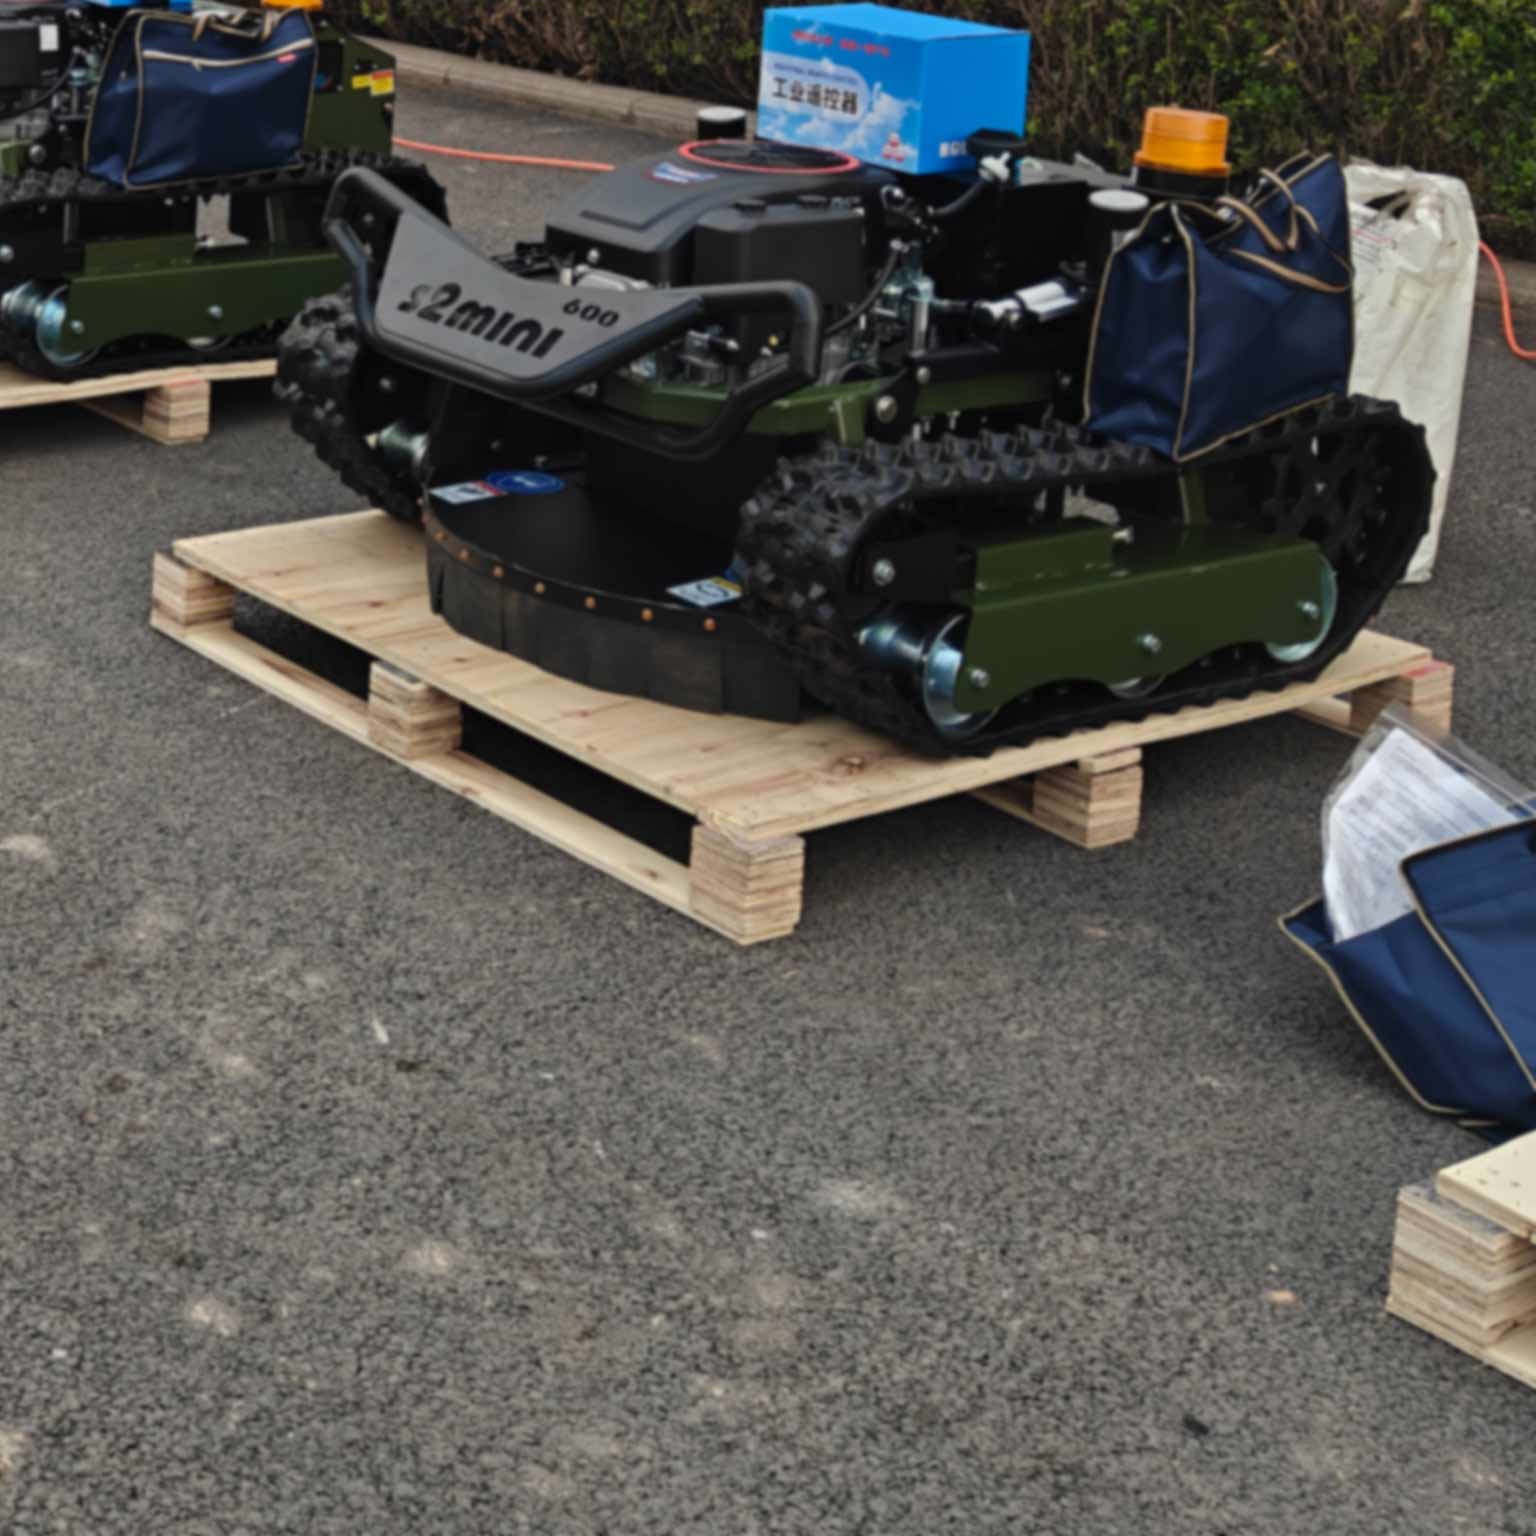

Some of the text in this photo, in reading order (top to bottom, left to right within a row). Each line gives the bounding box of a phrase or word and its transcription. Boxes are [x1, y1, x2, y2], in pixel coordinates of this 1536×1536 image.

[772, 76, 858, 115] 工业遥控器
[562, 298, 621, 328] 600
